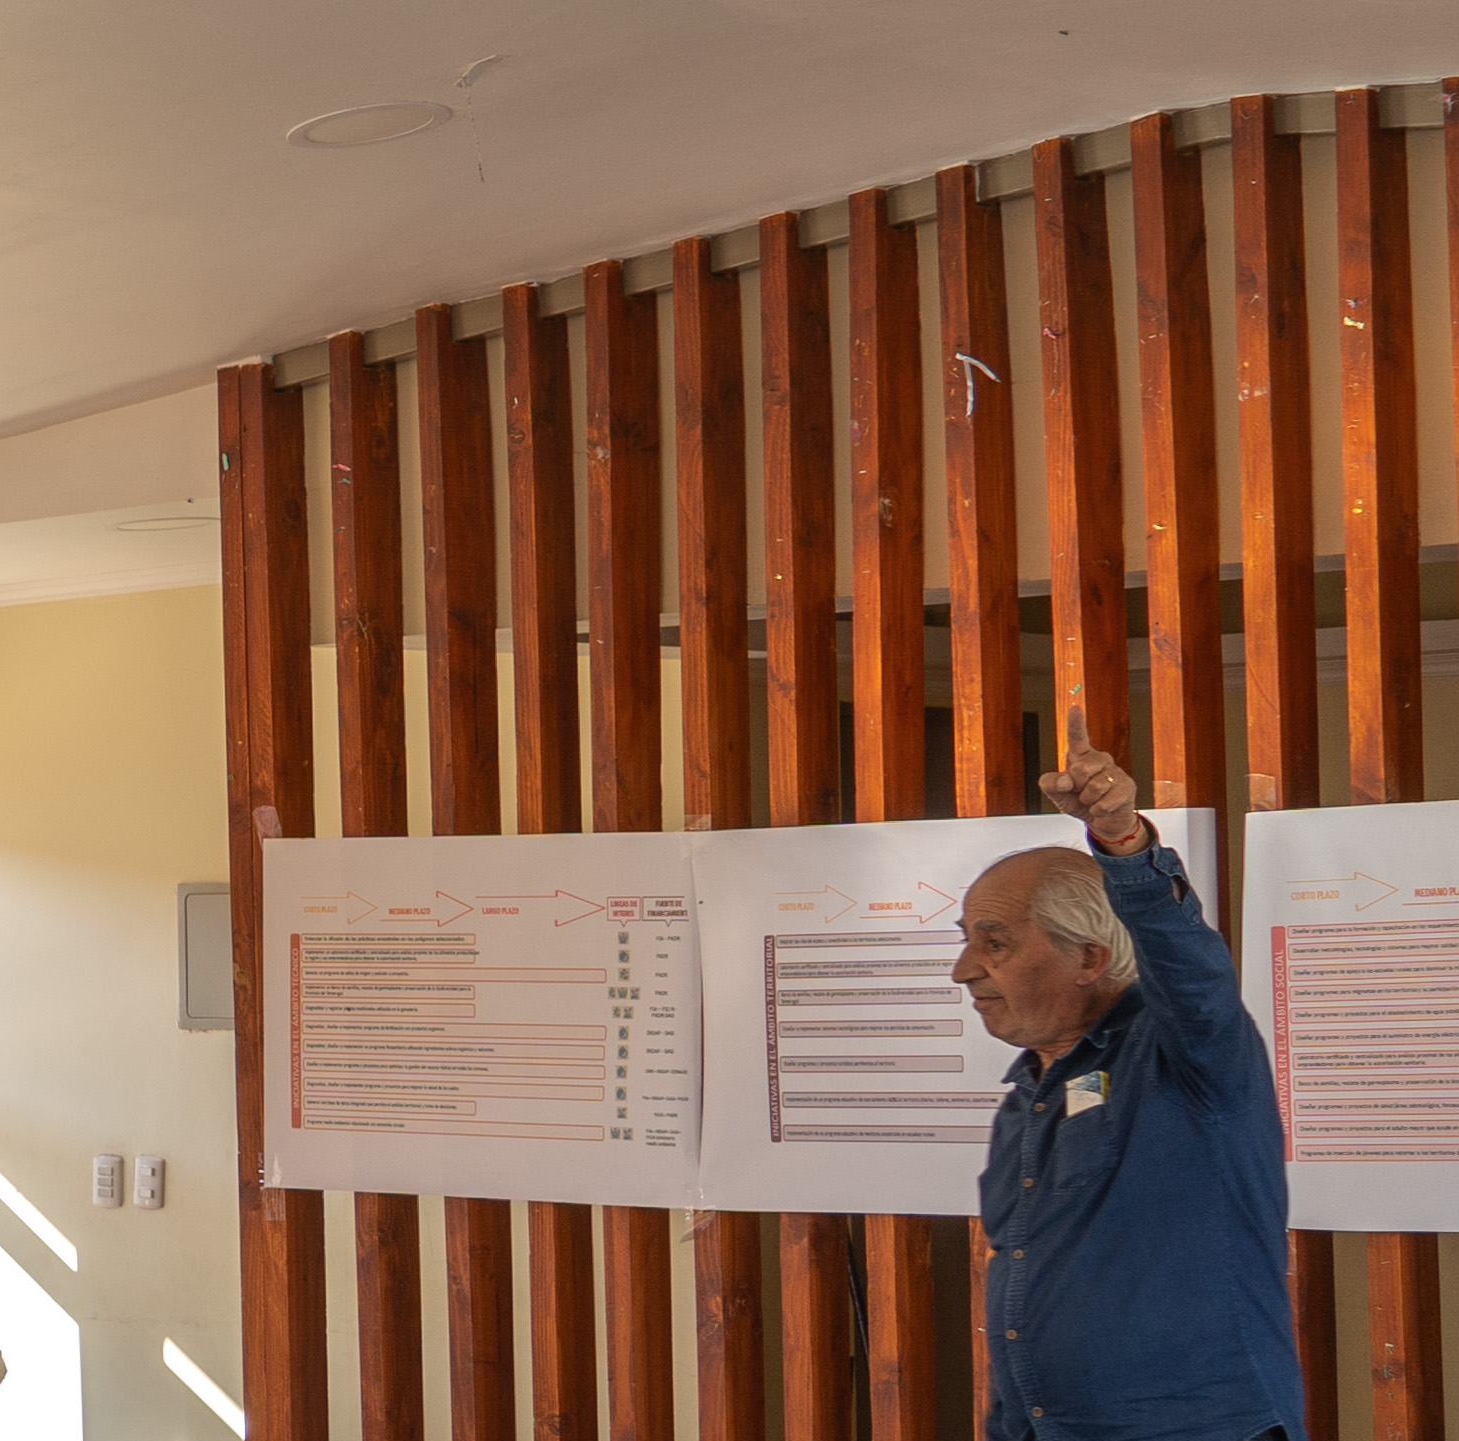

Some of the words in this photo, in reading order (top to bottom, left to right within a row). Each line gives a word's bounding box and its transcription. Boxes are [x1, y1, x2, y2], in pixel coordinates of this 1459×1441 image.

[1291, 891, 1316, 900] CORTO
[1317, 890, 1339, 899] PLAZO
[413, 907, 431, 915] PLAZO
[482, 907, 500, 915] LARGO
[501, 907, 519, 915] PLAZO
[797, 902, 815, 911] PLAZO
[894, 902, 912, 910] PLAZO
[291, 948, 299, 986] TÉCNICO
[766, 937, 775, 1000] TERRITORIAL
[1274, 949, 1285, 988] SOCIAL
[291, 990, 299, 1026] ÁMBITO
[1274, 991, 1286, 1035] ÁMBITO
[293, 1028, 300, 1039] EL
[294, 1041, 300, 1053] EN
[1277, 1038, 1286, 1051] EL
[769, 1048, 776, 1060] EL
[1278, 1055, 1287, 1069] EN
[770, 1062, 777, 1076] EN
[771, 1079, 780, 1137] INICIATIVAS
[1278, 1072, 1290, 1134] INICIATIVAS
